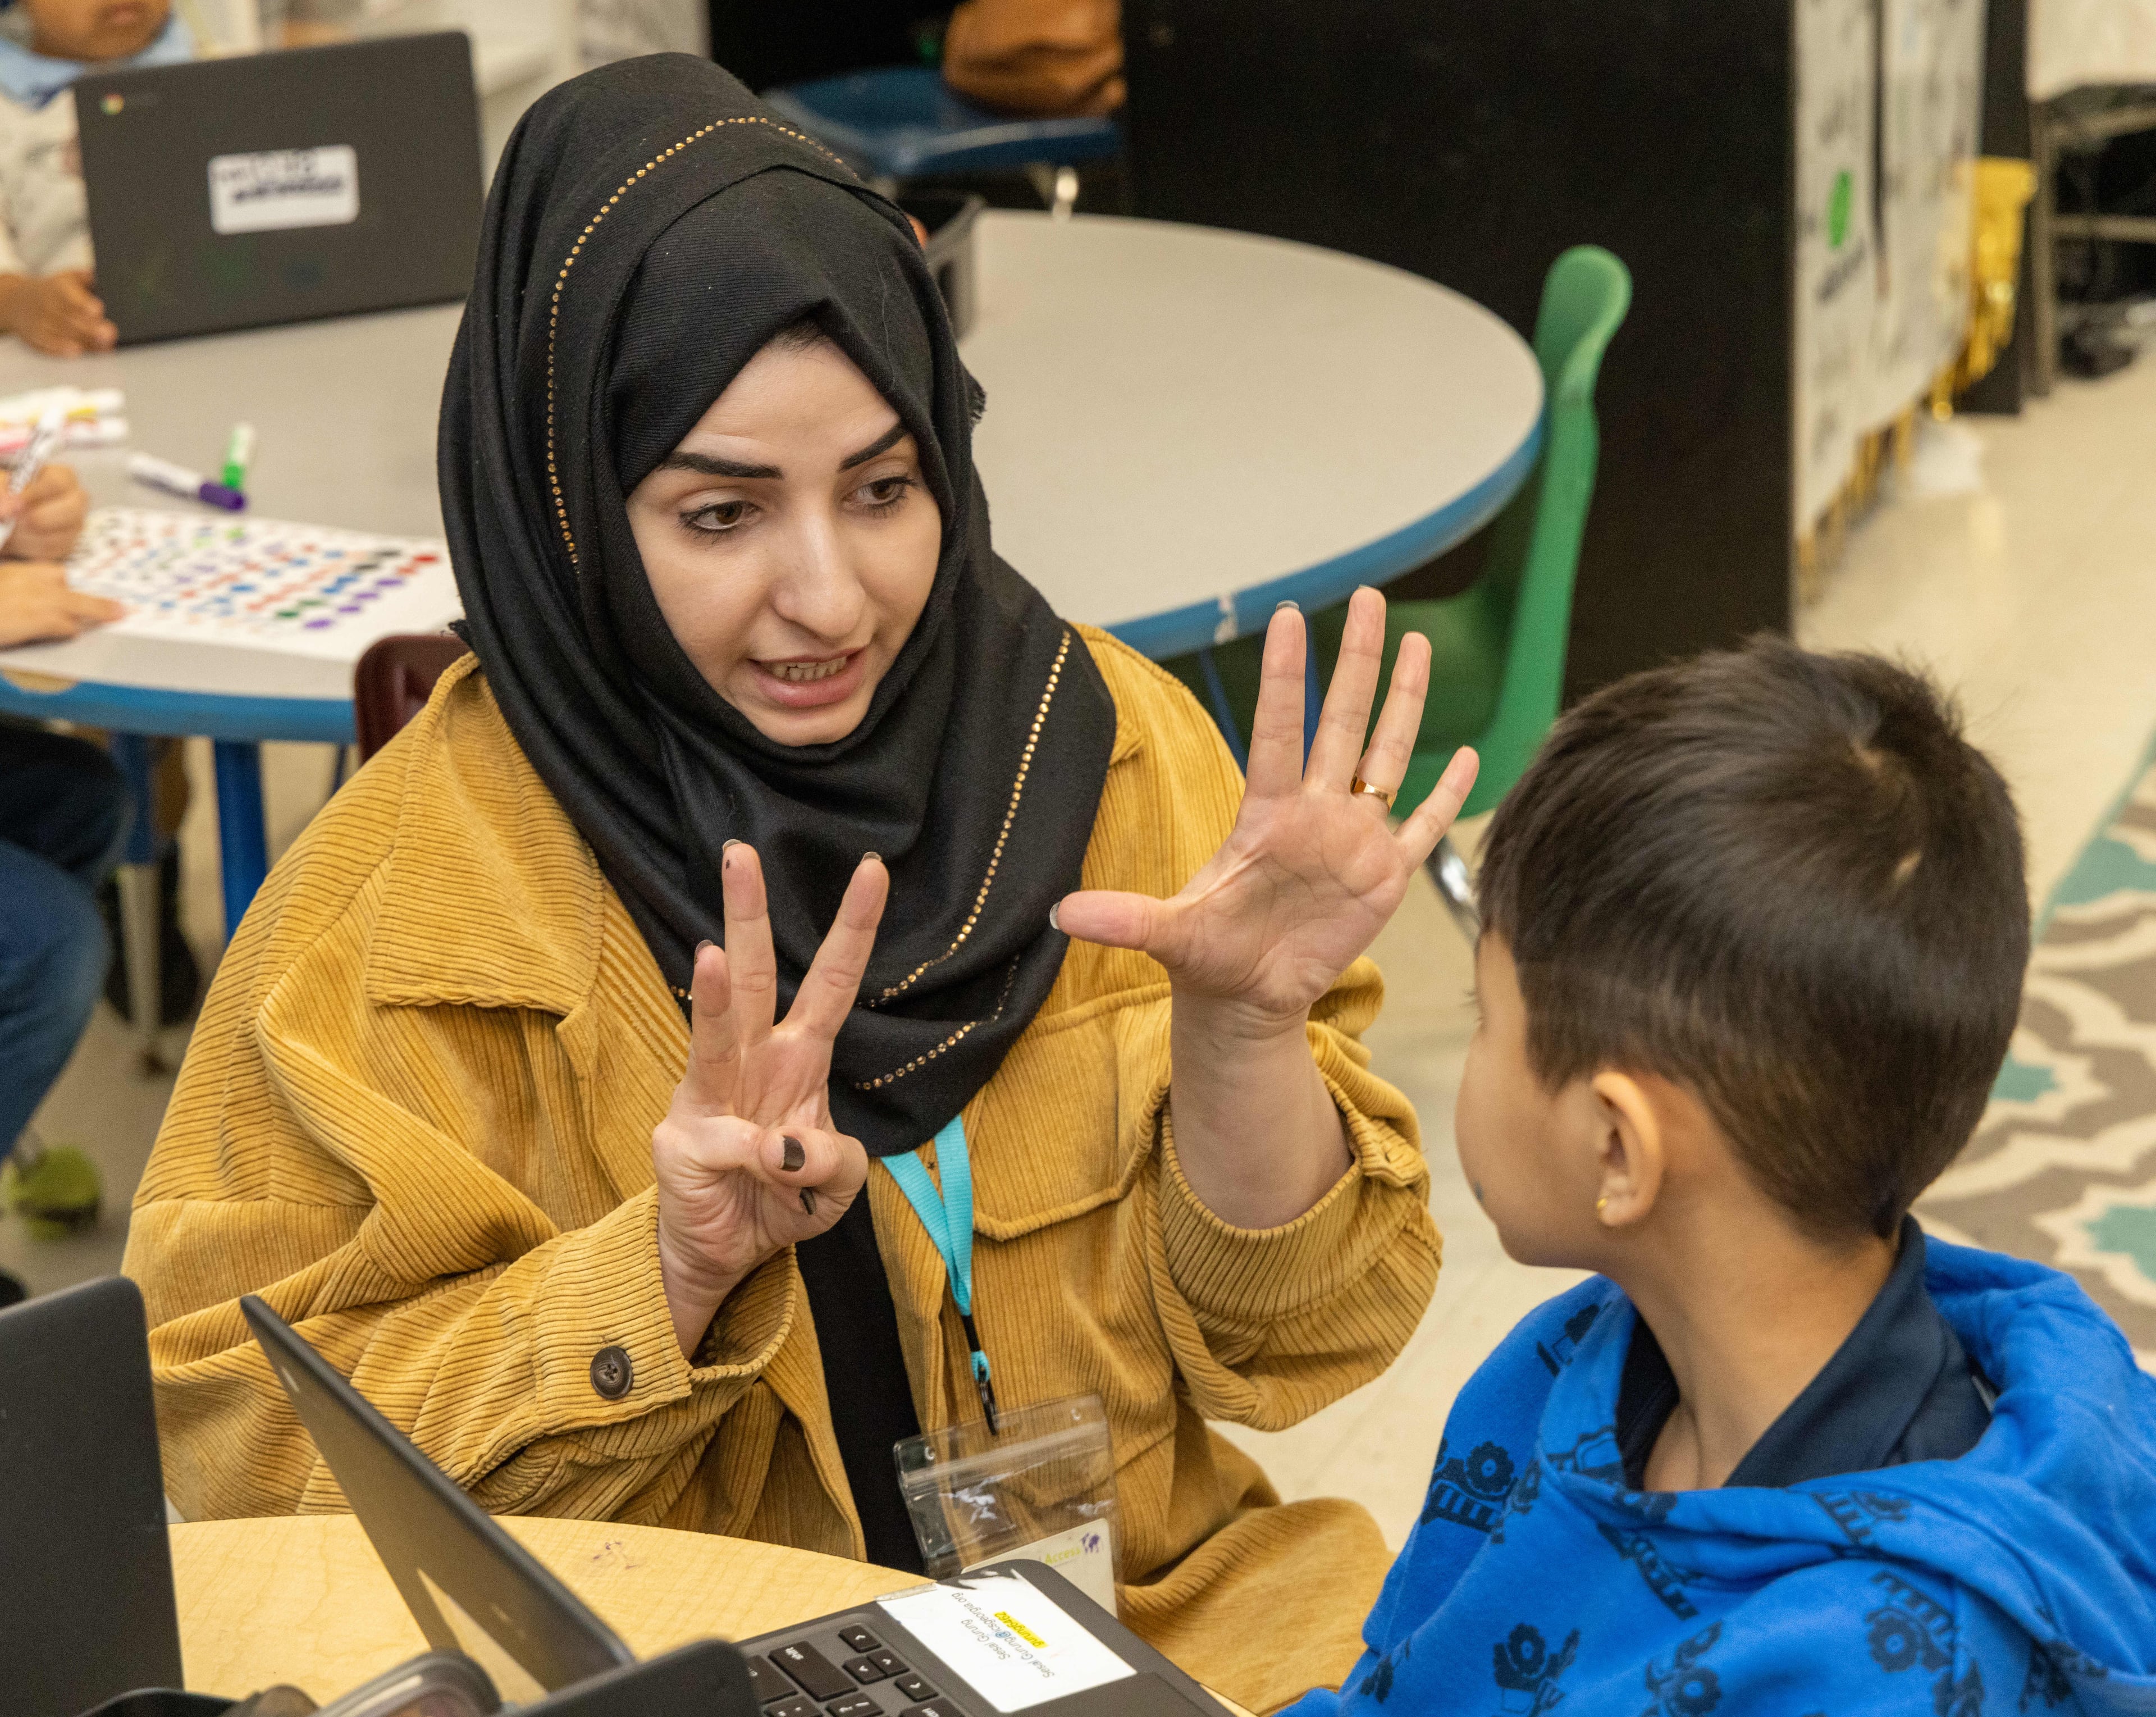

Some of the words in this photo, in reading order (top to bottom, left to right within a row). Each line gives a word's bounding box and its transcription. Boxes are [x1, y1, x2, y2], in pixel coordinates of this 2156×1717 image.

[1045, 1546, 1080, 1564] Access
[961, 1619, 990, 1643] Gurung
[994, 1611, 1045, 1647] gurung6462
[785, 1647, 803, 1660] shift
[984, 1642, 1010, 1660] Sesal
